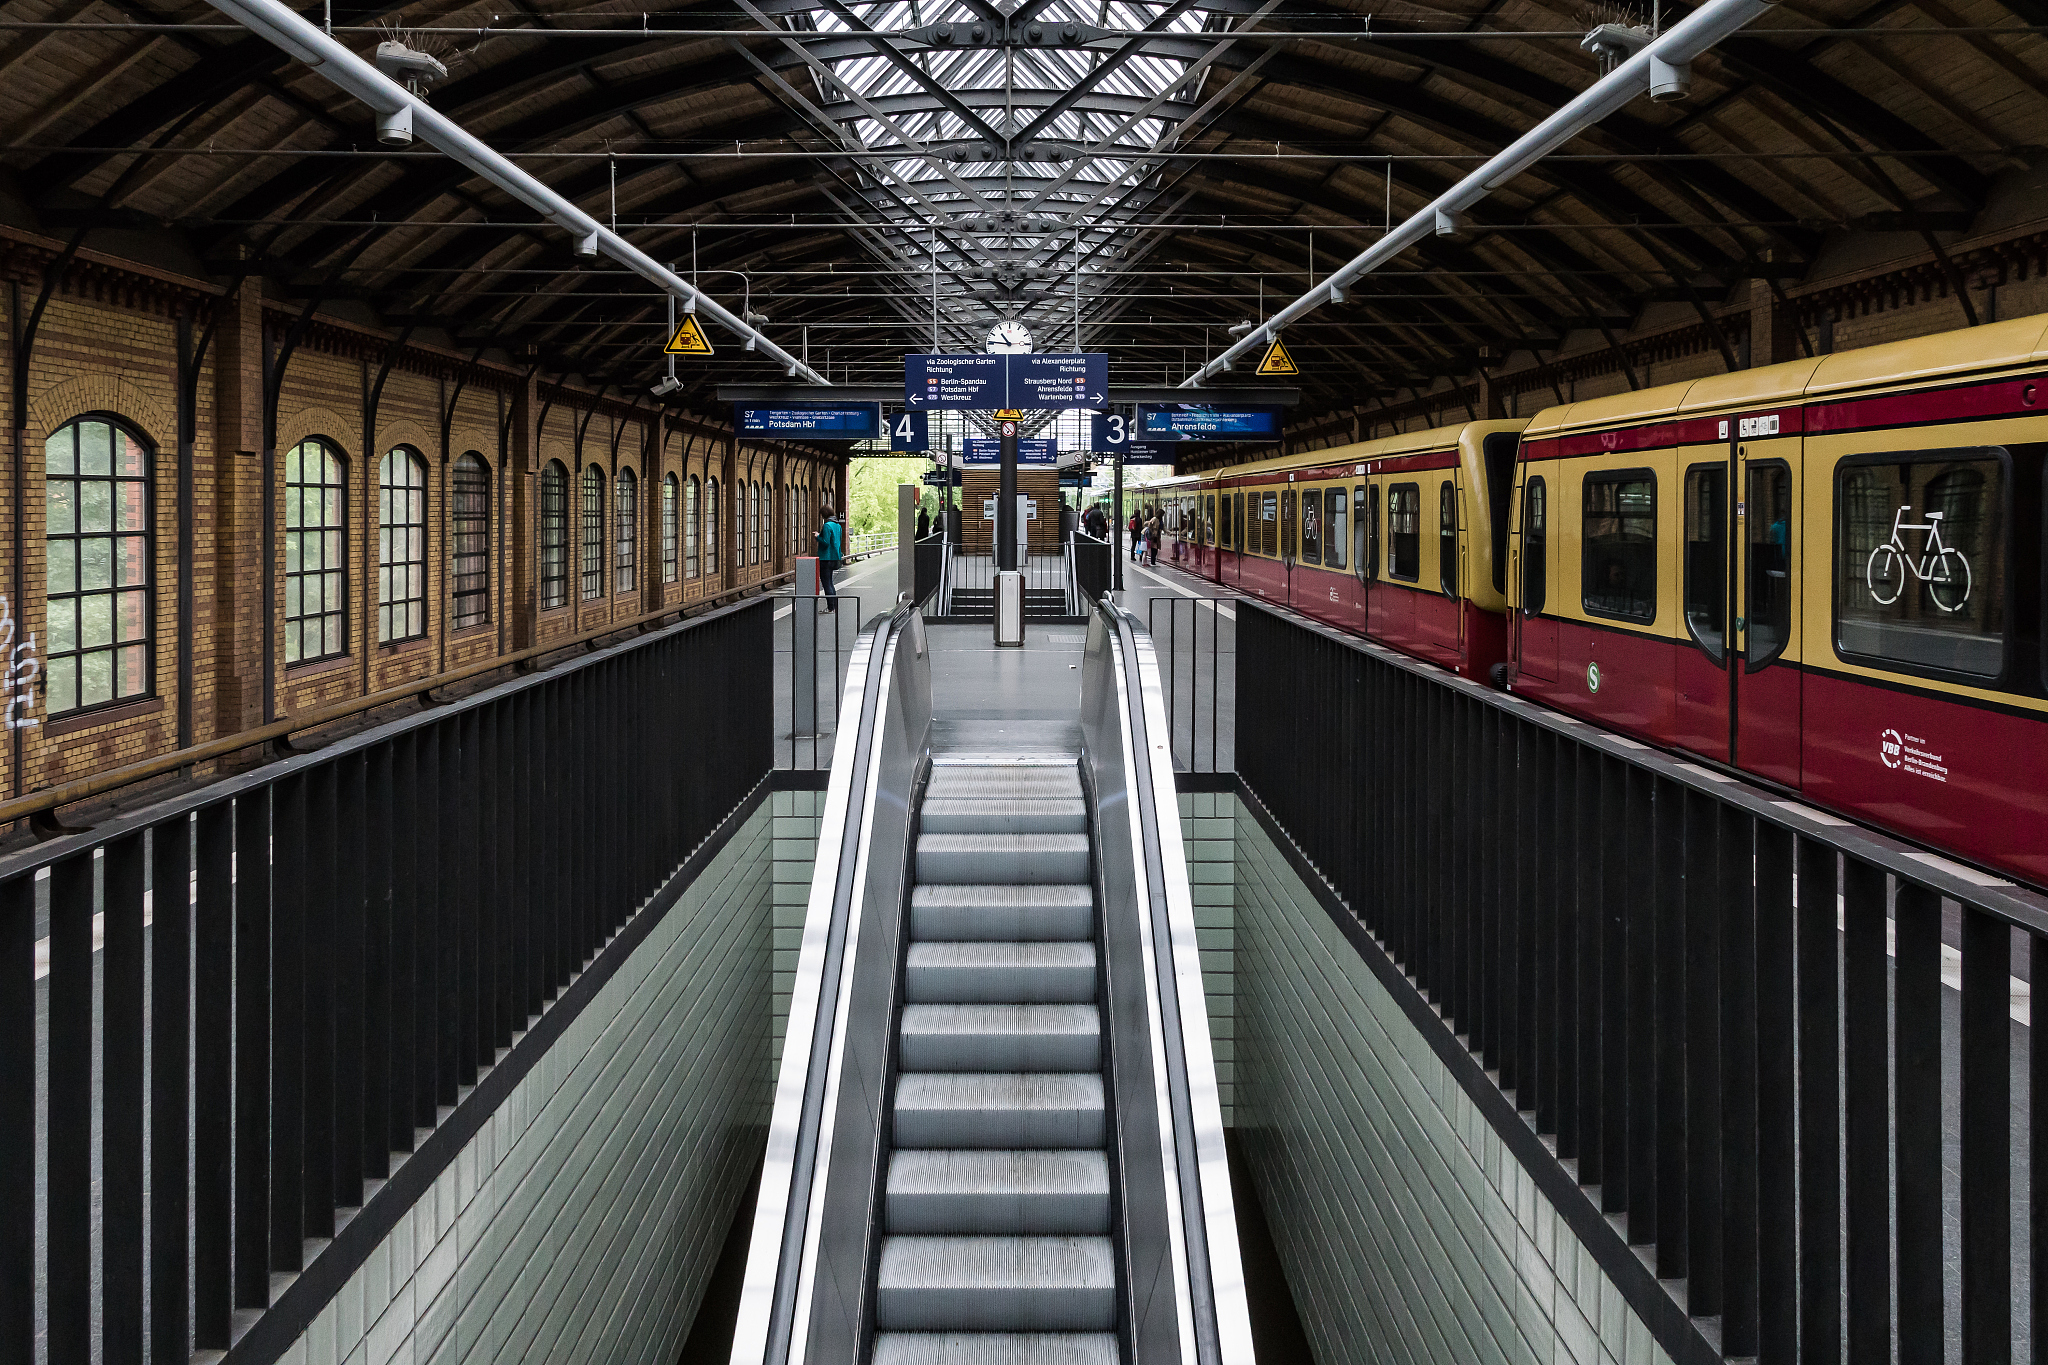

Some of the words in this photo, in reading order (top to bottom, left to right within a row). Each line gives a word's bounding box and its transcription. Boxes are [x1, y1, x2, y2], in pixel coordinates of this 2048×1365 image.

[936, 358, 975, 366] Zoologischer
[1041, 357, 1086, 366] Alexanderplatz
[926, 366, 953, 374] Richtung
[1059, 365, 1086, 374] Richtung
[940, 378, 987, 386] Berlin-Spandau
[1024, 377, 1056, 386] Strausberg
[1057, 377, 1073, 385] Nord
[1037, 385, 1073, 393] Ahrensfelde
[1038, 393, 1073, 401] Wartenberg
[744, 410, 755, 418] S7
[1146, 412, 1157, 421] S7
[768, 420, 802, 428] Potsdam
[802, 420, 816, 428] Hbf
[1171, 422, 1217, 430] Ahrensfelde
[895, 414, 915, 443] 4
[1106, 414, 1126, 444] 3
[839, 511, 845, 519] H
[1590, 665, 1598, 690] S
[1882, 740, 1900, 755] VBB
